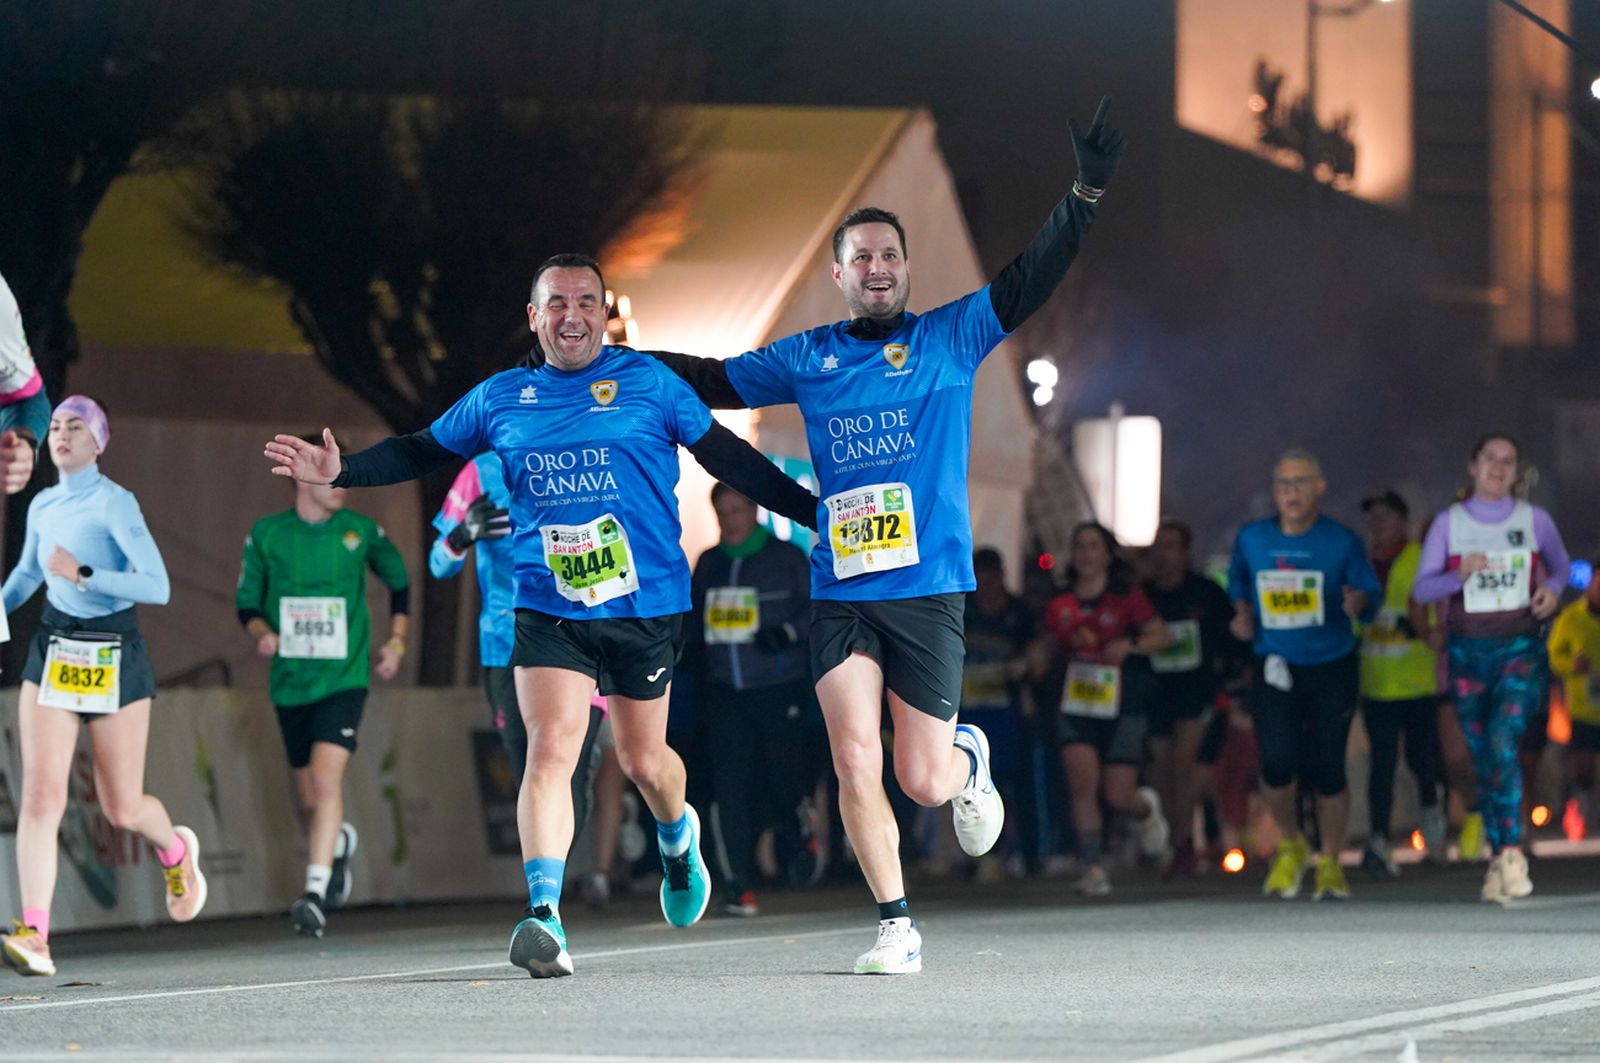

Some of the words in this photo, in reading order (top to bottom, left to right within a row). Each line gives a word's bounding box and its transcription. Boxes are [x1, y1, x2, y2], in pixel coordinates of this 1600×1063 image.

[828, 414, 873, 438] ORO
[880, 408, 909, 429] DE
[525, 450, 576, 474] ORO
[582, 447, 610, 467] DE
[831, 431, 915, 463] CÁNAVA
[528, 470, 619, 497] CÁNAVA
[864, 495, 875, 504] DE
[581, 531, 591, 541] DE
[840, 514, 901, 548] 13872
[553, 544, 567, 554] SAN
[561, 546, 616, 581] 3444
[59, 664, 105, 688] 8832
